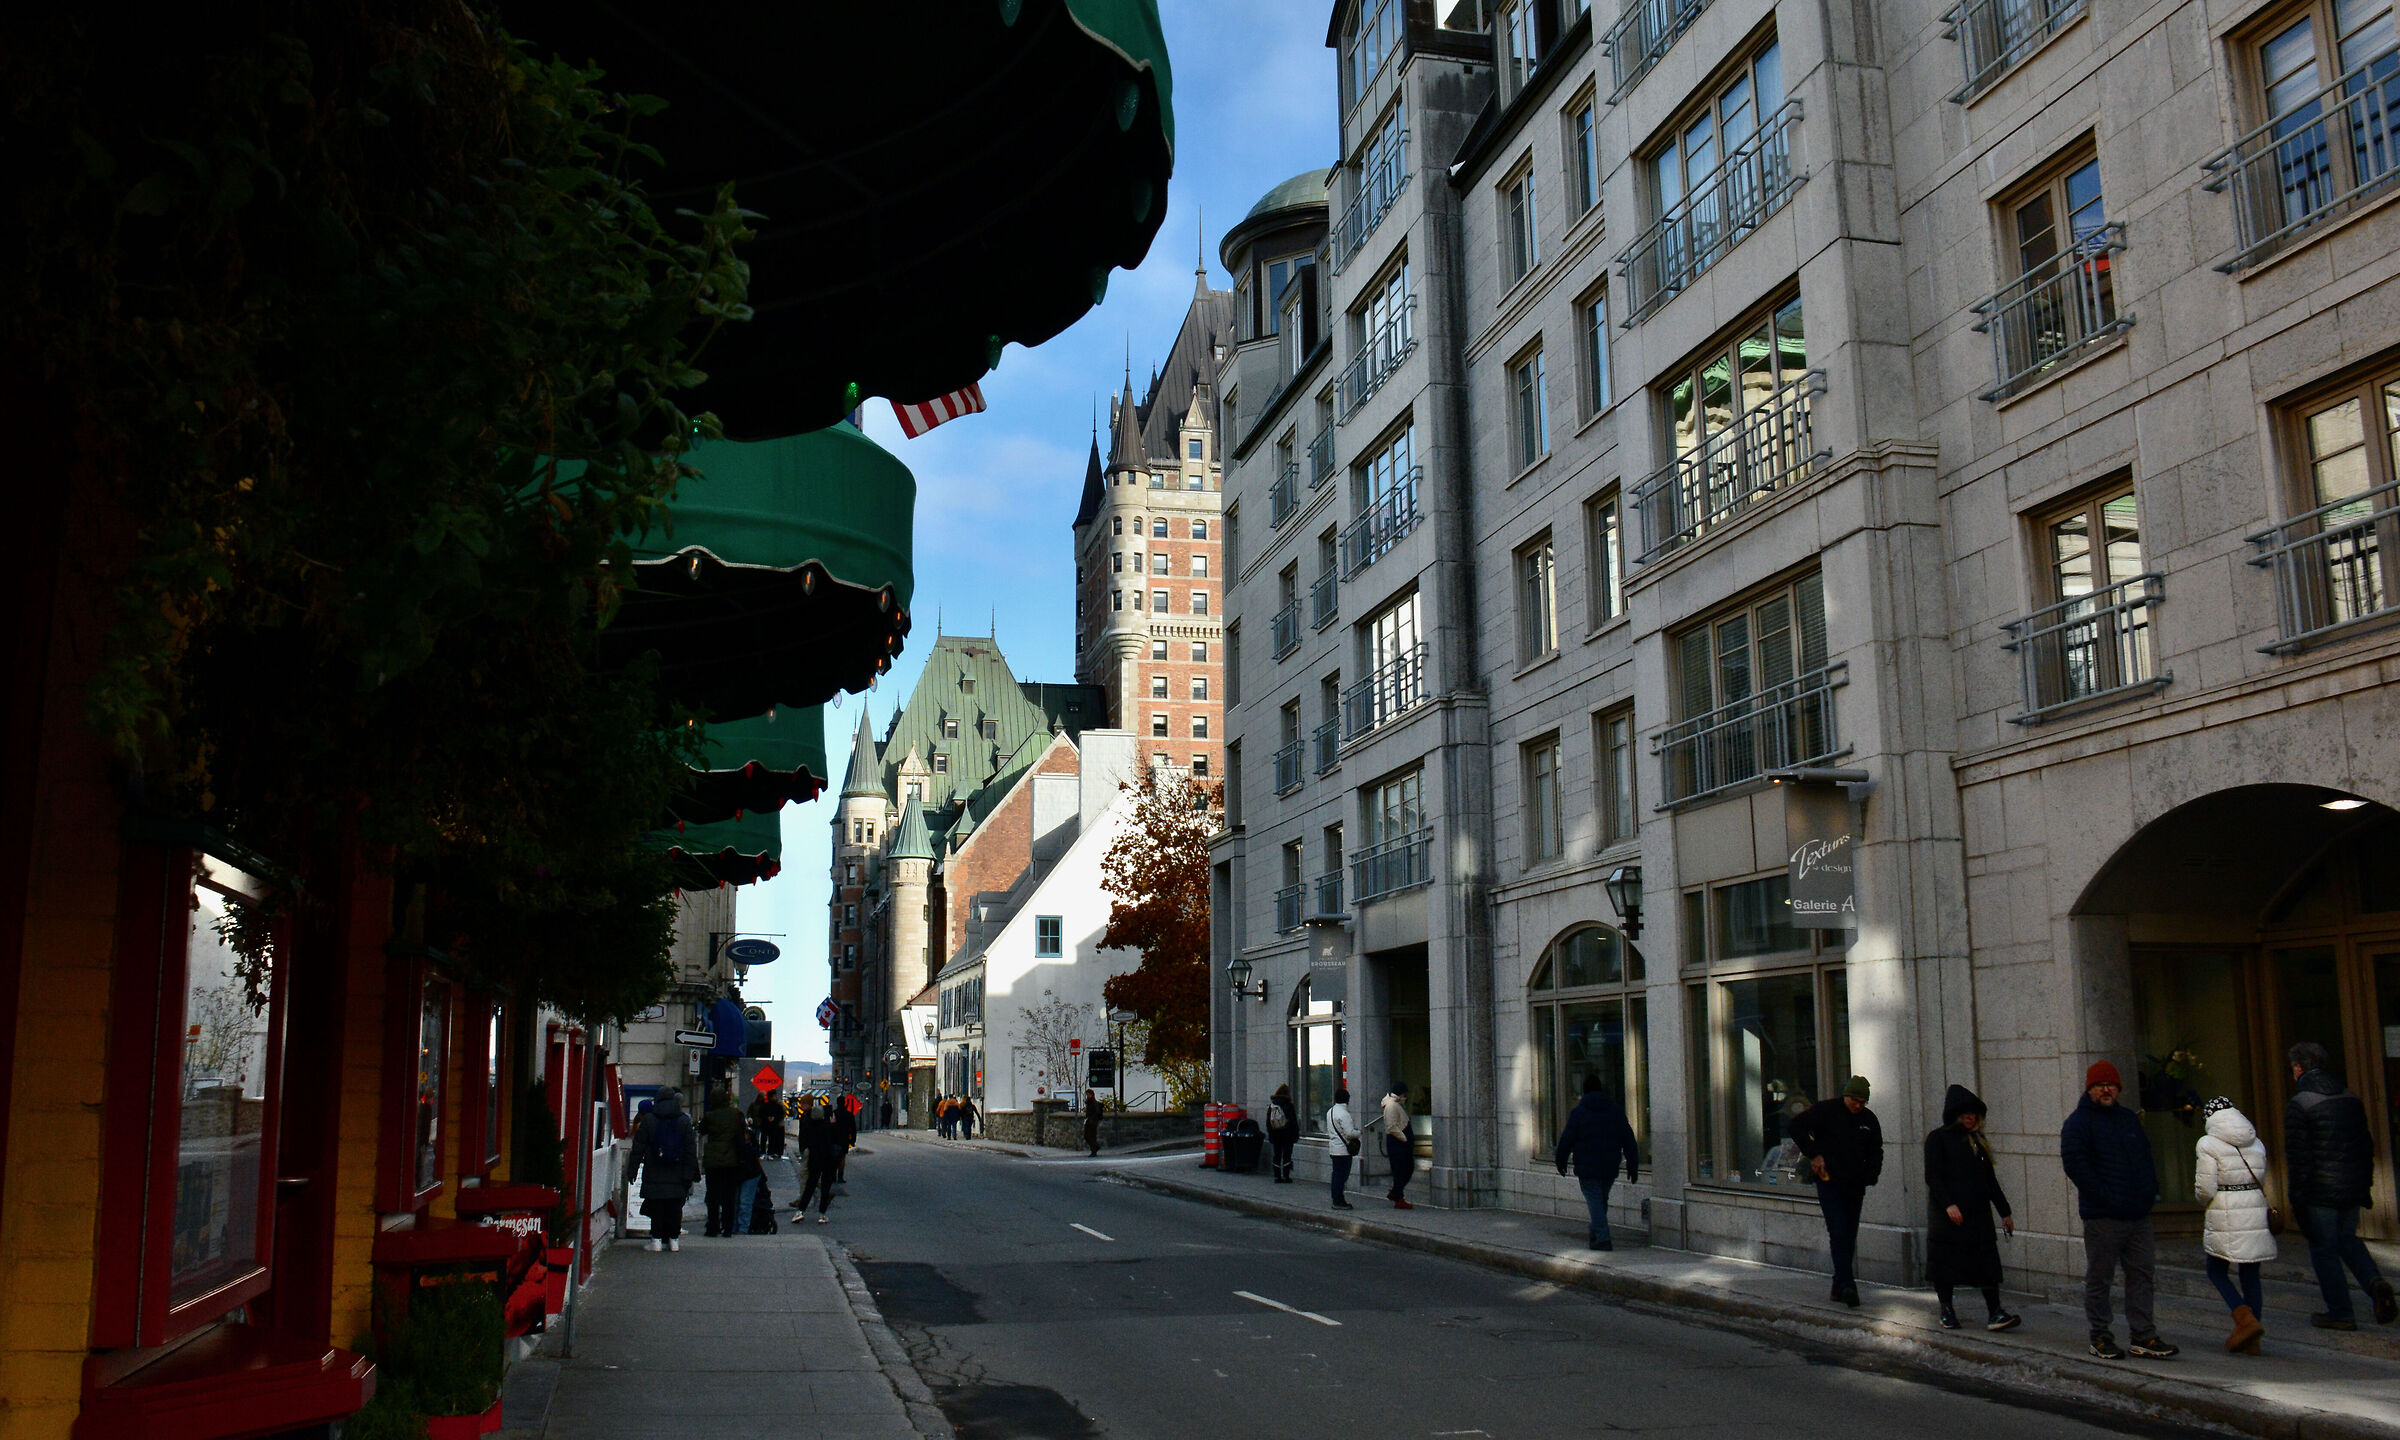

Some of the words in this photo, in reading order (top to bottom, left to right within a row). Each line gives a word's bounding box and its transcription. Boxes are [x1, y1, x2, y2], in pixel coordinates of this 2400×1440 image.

[1821, 864, 1852, 874] design
[1793, 900, 1837, 911] Galerie
[1841, 895, 1855, 912] A
